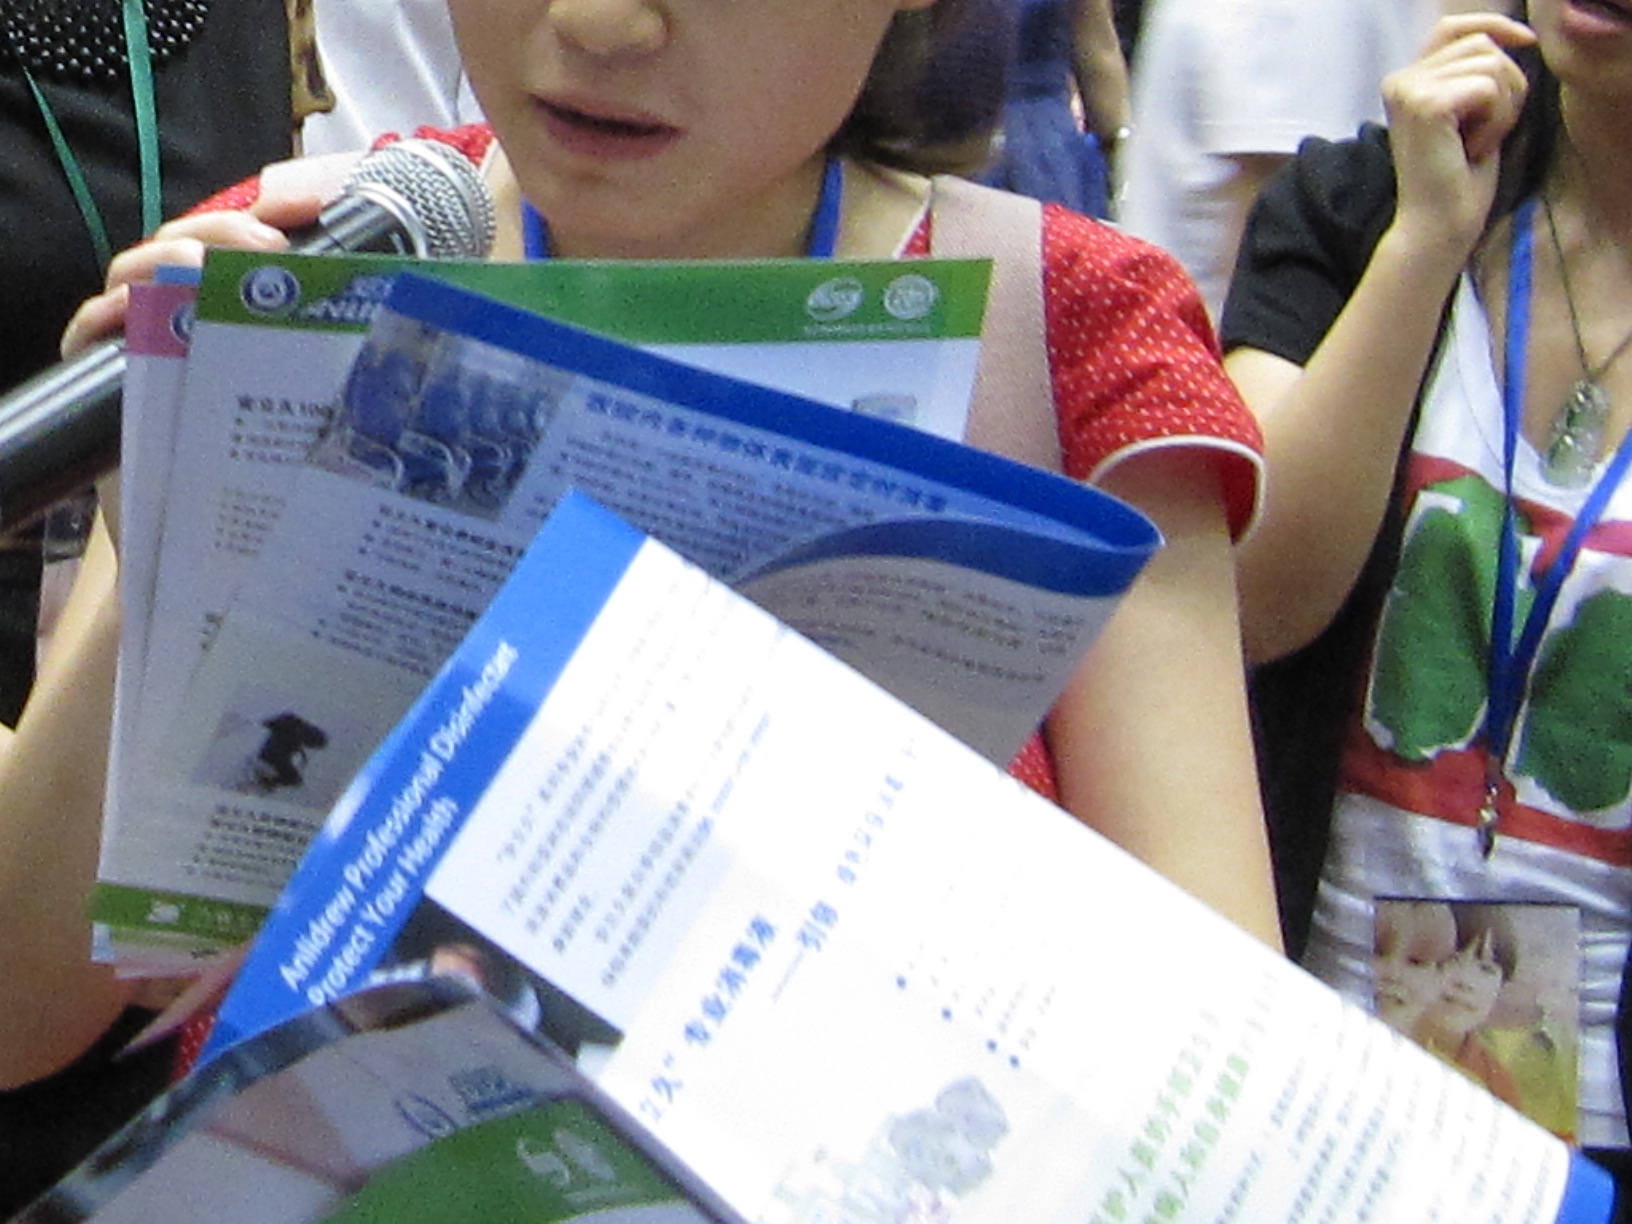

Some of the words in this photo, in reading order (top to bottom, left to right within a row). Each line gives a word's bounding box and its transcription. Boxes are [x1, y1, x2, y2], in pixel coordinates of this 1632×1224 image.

[306, 923, 377, 1007] Protect
[359, 867, 411, 927] Your
[396, 795, 459, 876] Health
[342, 749, 445, 891] Professional
